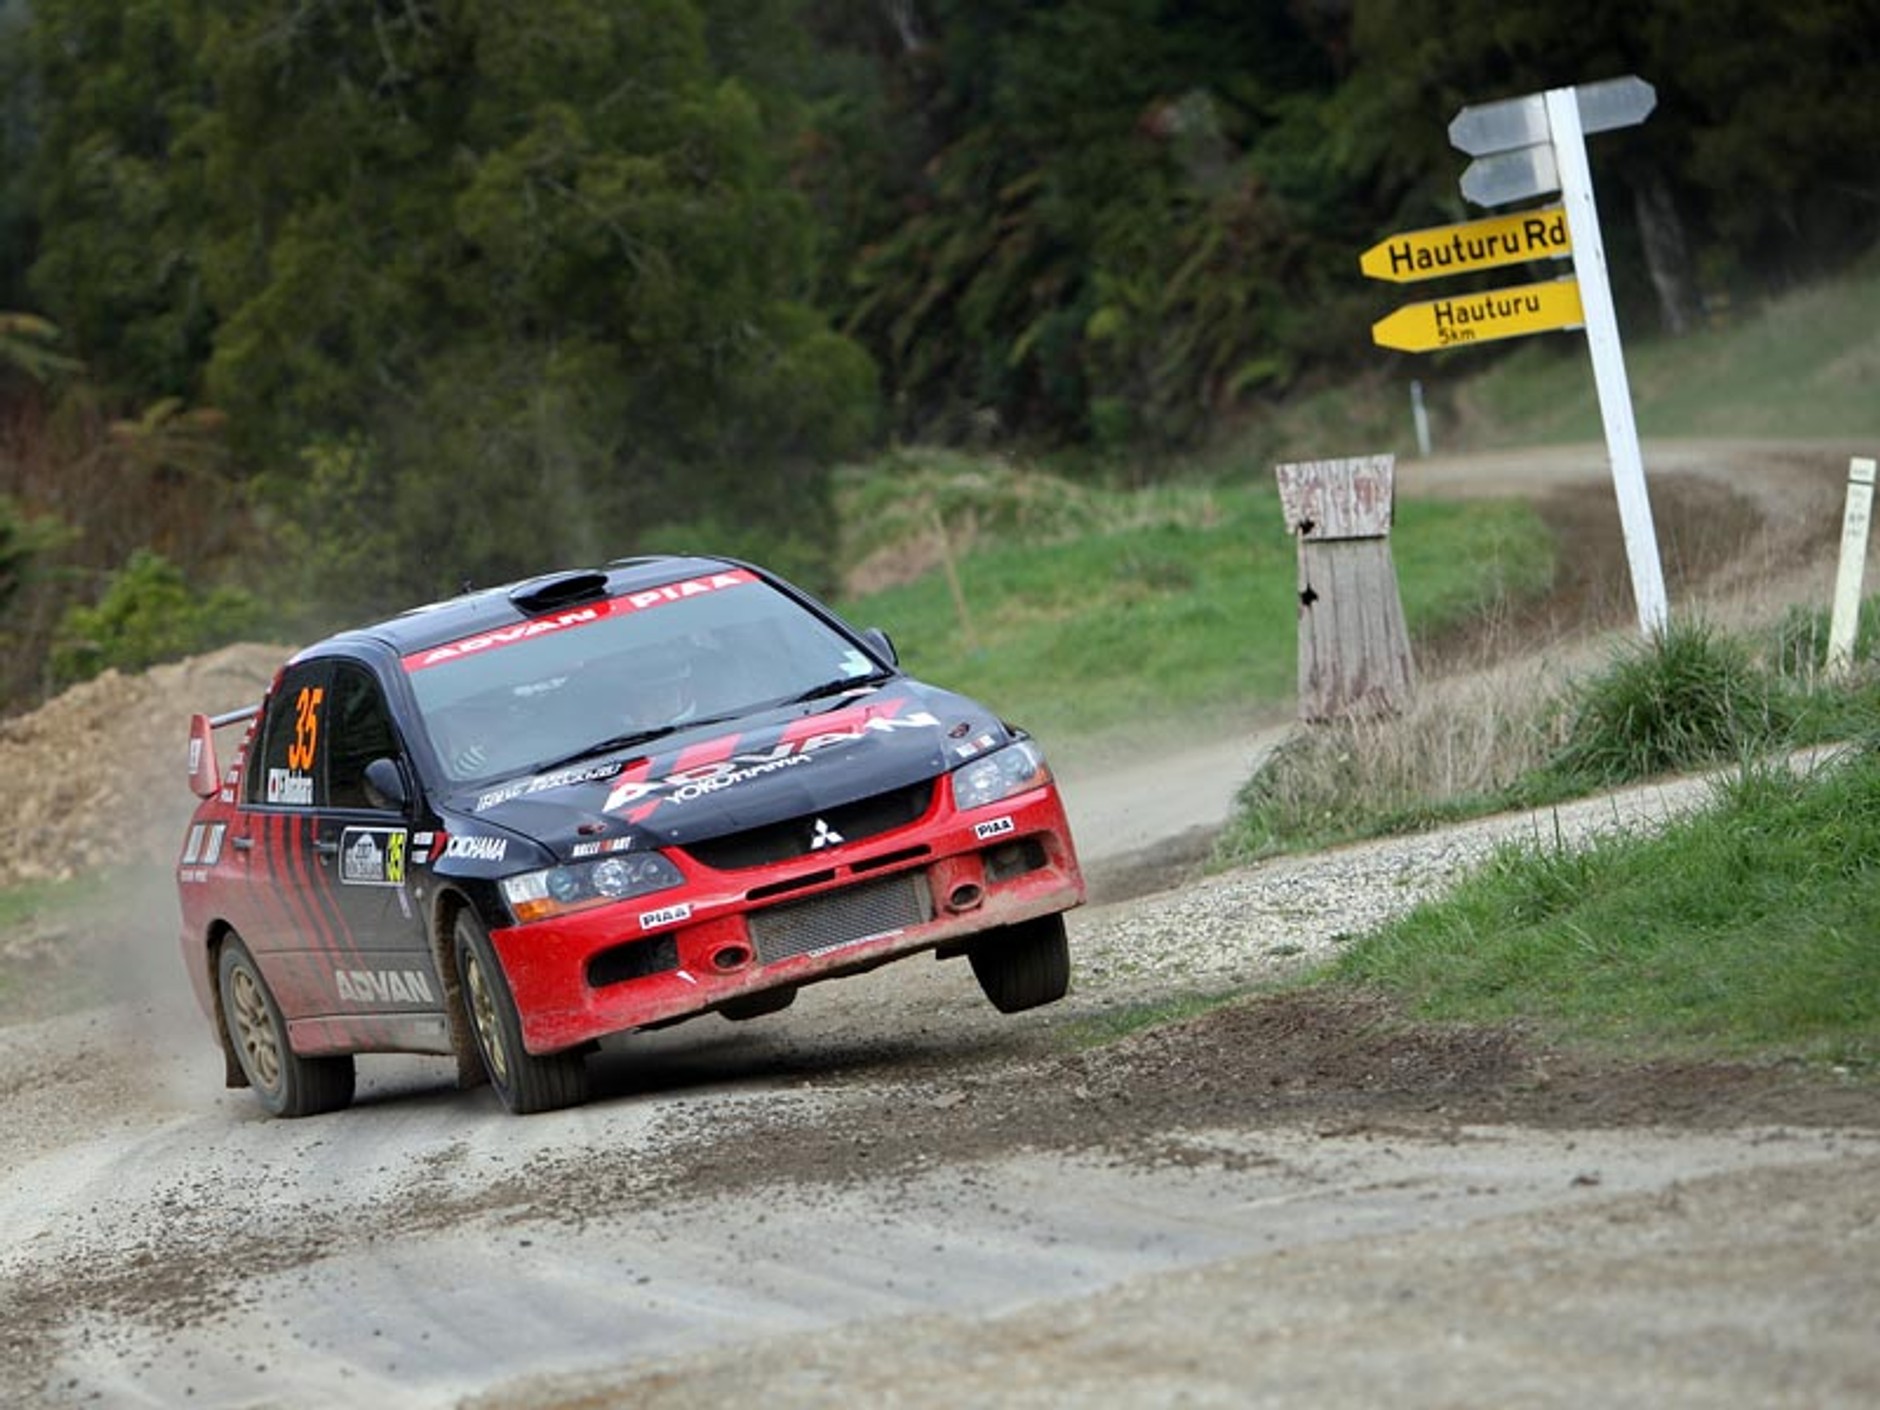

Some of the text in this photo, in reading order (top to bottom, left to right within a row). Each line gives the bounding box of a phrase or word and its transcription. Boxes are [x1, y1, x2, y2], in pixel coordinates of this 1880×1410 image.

[1389, 216, 1567, 274] Hauturu Rd
[1434, 295, 1540, 328] Hauturu
[421, 574, 743, 665] ADVAN PIAA
[288, 687, 323, 770] 35
[978, 819, 1011, 836] PIAA
[643, 907, 687, 926] PIAA
[336, 970, 434, 1003] ADVAN
